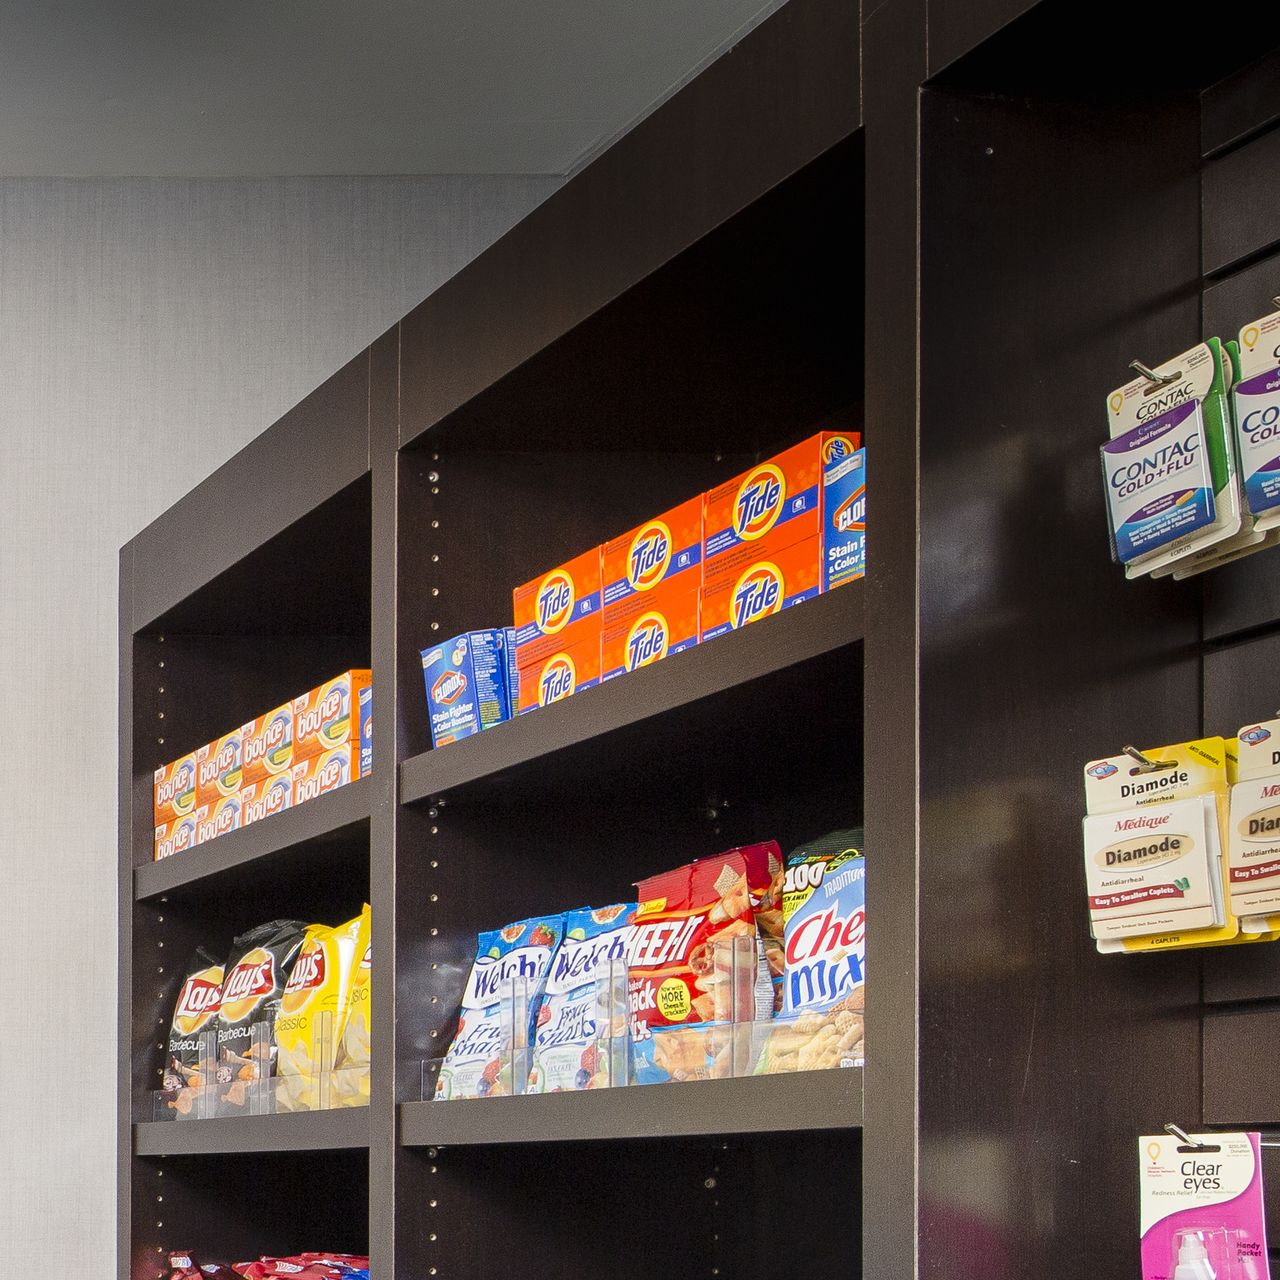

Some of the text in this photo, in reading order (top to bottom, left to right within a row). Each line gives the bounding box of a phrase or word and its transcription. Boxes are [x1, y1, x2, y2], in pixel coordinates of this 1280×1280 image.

[1135, 383, 1195, 421] CONTAC
[829, 439, 844, 464] Tide
[1129, 423, 1173, 449] Original Formula
[1111, 432, 1202, 490] CONTAC
[1117, 453, 1195, 499] COLD+FLU
[735, 477, 781, 539] Tide
[629, 533, 668, 587] Tide
[828, 540, 859, 561] Stain
[834, 554, 859, 572] Color
[537, 580, 571, 631] Tide
[732, 575, 781, 630] Tide
[628, 623, 665, 672] Tide
[434, 671, 465, 704] CLOROX
[539, 665, 572, 707] Tide
[296, 690, 341, 743] bounce
[432, 711, 450, 724] Stain
[243, 719, 285, 767] bounce
[199, 744, 235, 788] bounce
[296, 759, 341, 804] bounce
[157, 769, 189, 808] bounce
[1120, 770, 1189, 799] Diamode
[1135, 794, 1176, 806] Antidiarrheal
[244, 785, 284, 825] bounce
[198, 806, 234, 845] bounce
[157, 826, 189, 861] bounce
[1105, 837, 1181, 867] Diamode
[782, 861, 827, 893] 100
[1100, 875, 1145, 888] Antidiarrheal
[1234, 867, 1260, 878] Easy To
[1094, 886, 1175, 906] Easy To Swallow Caplets
[1155, 936, 1181, 945] CAPLETS
[221, 961, 271, 1004] Lay's
[661, 990, 684, 1003] MORE
[217, 1024, 257, 1043] Barbecue
[273, 1013, 308, 1033] Classic
[538, 1014, 597, 1047] Snacks
[168, 1038, 207, 1052] Barbecue
[1180, 1160, 1223, 1177] Clear
[1183, 1176, 1222, 1191] eyes
[1151, 1189, 1194, 1197] Redness Relief
[1236, 1241, 1261, 1252] Handy
[1237, 1249, 1263, 1258] Pocket
